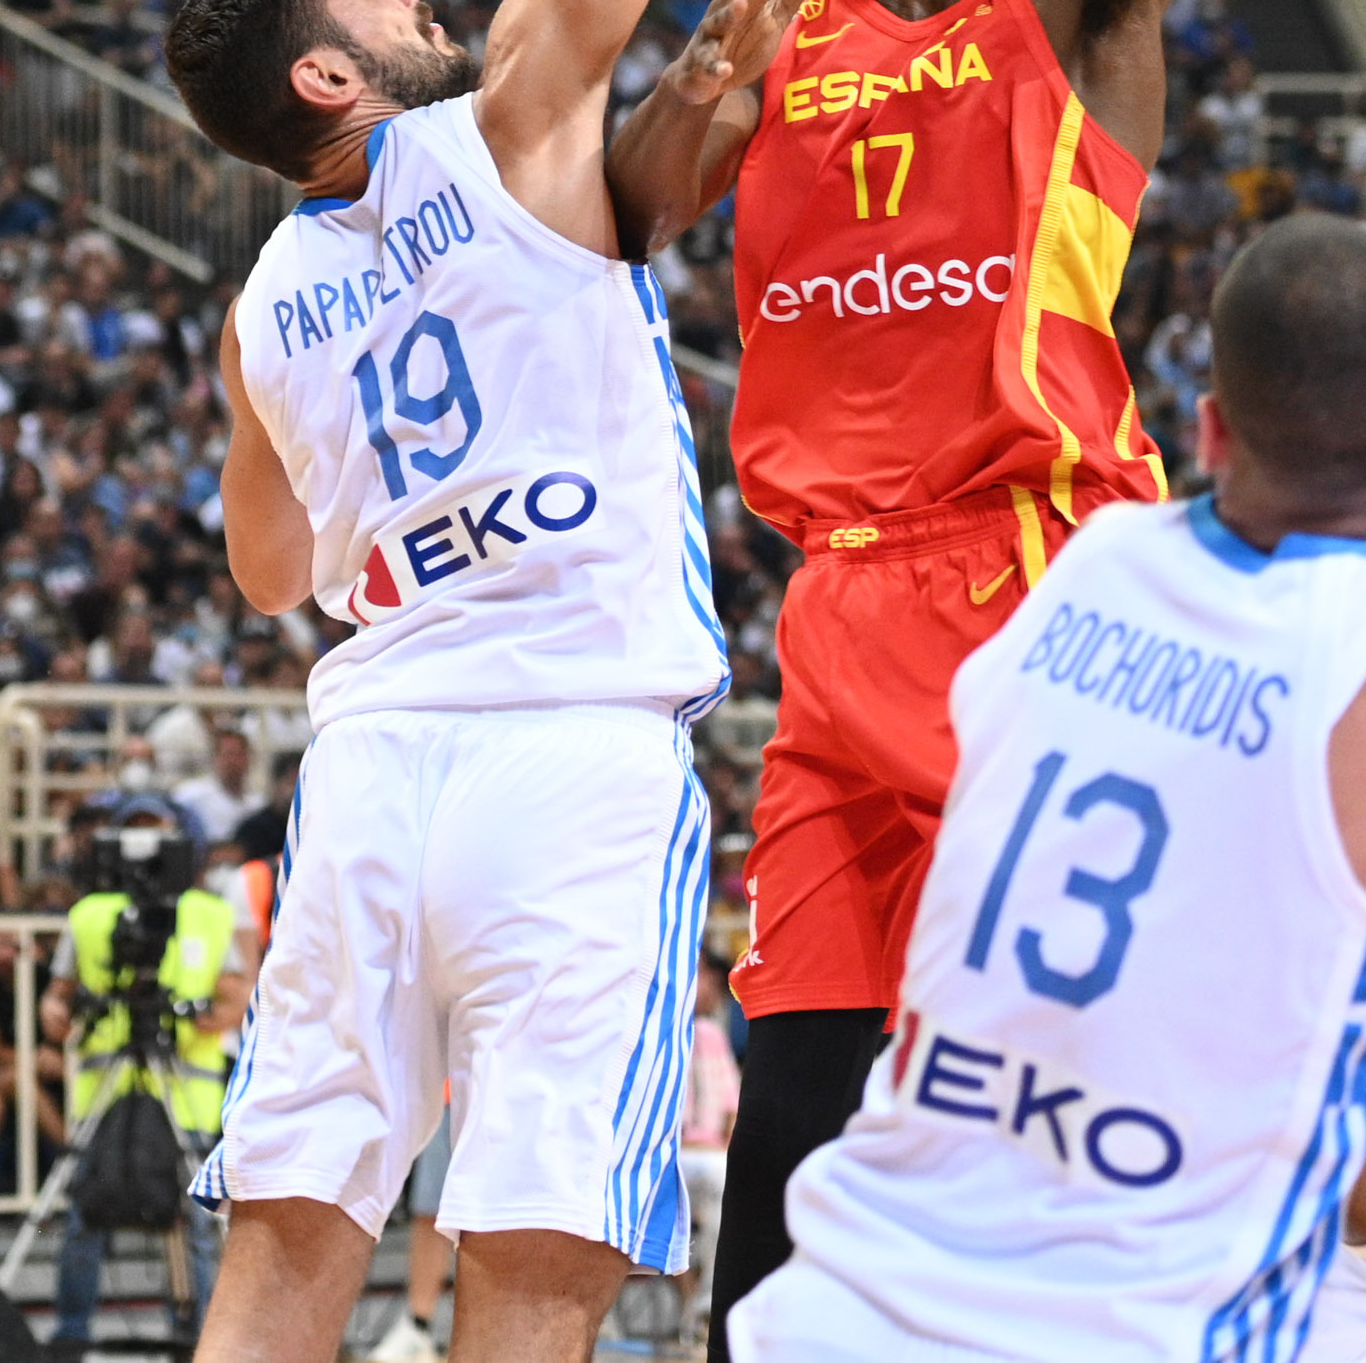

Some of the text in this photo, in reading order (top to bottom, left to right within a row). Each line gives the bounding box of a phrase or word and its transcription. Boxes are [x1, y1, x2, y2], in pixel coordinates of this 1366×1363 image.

[851, 133, 914, 219] 17
[760, 253, 1015, 323] endesa
[352, 309, 483, 502] 19
[401, 471, 598, 588] EKO
[829, 527, 880, 549] ESP
[1021, 603, 1290, 757] BOCHORIDIS
[965, 751, 1170, 1008] 13
[915, 1039, 1183, 1188] EKO
